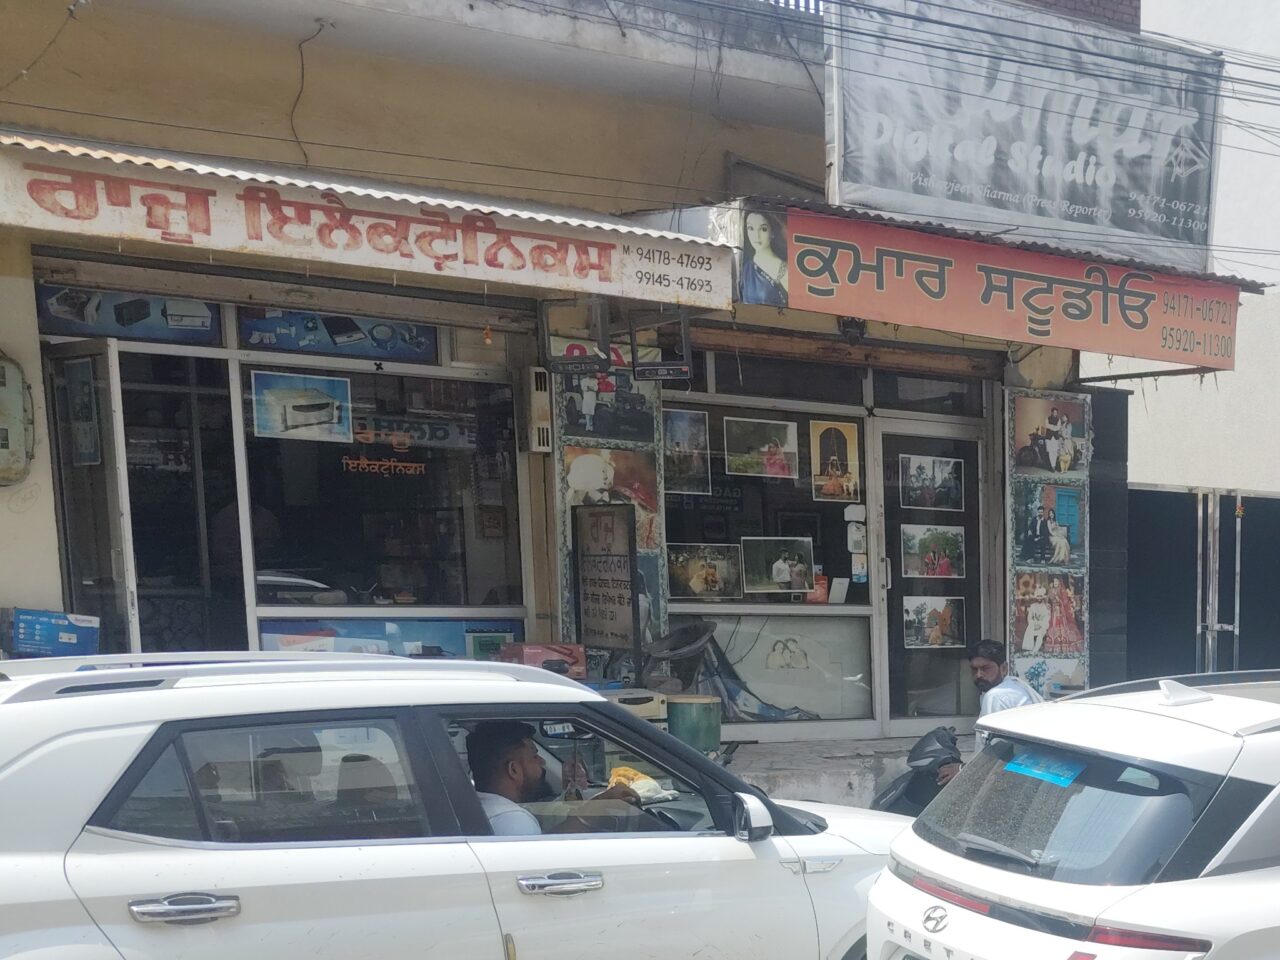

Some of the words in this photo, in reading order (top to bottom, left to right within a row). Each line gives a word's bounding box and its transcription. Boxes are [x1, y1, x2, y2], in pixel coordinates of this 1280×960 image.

[636, 247, 713, 272] 94178-47693
[635, 270, 713, 293] 99145-47693
[793, 234, 953, 299] ਕੁਮਾਰ
[976, 261, 1158, 337] ਸਟੂਡੀਓ
[1163, 291, 1233, 326] 94171-06721
[1161, 326, 1233, 358] 95920-11300
